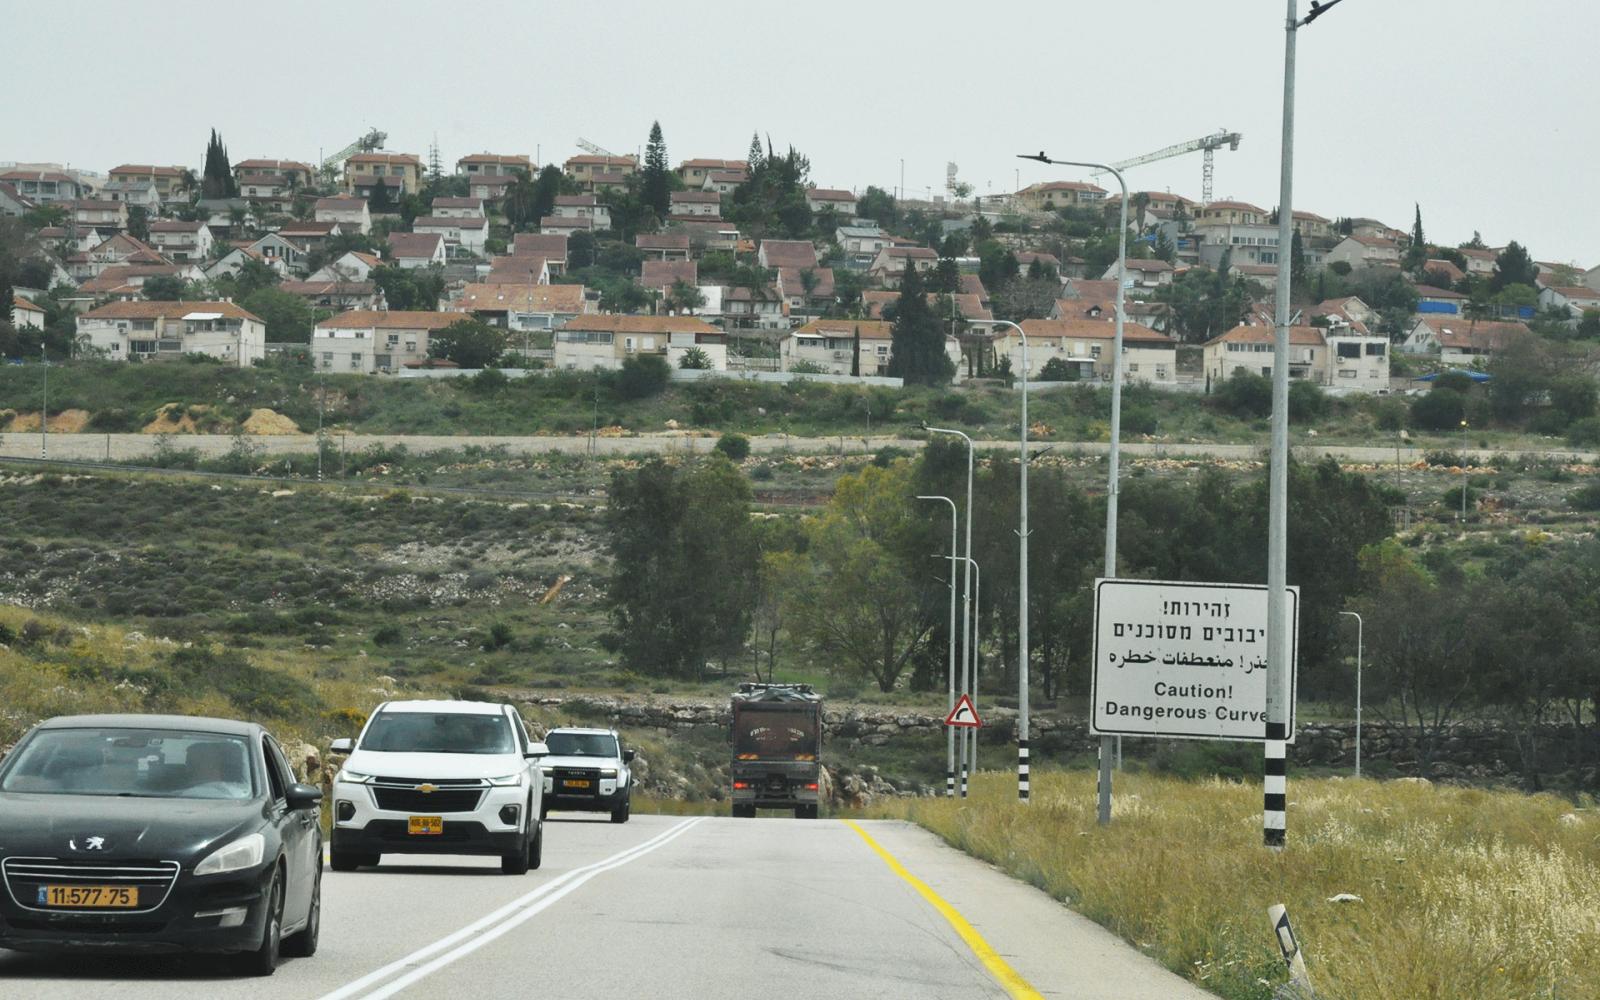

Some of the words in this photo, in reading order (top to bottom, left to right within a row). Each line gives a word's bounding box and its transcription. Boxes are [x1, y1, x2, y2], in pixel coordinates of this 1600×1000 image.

[1163, 601, 1231, 618] זהירות!
[1113, 622, 1192, 641] מסוכנים
[1203, 627, 1265, 643] יבובים
[1162, 651, 1234, 668] منعطفات
[1154, 681, 1233, 699] Caution!
[1105, 701, 1207, 721] Dangerous
[1215, 706, 1268, 722] Curve
